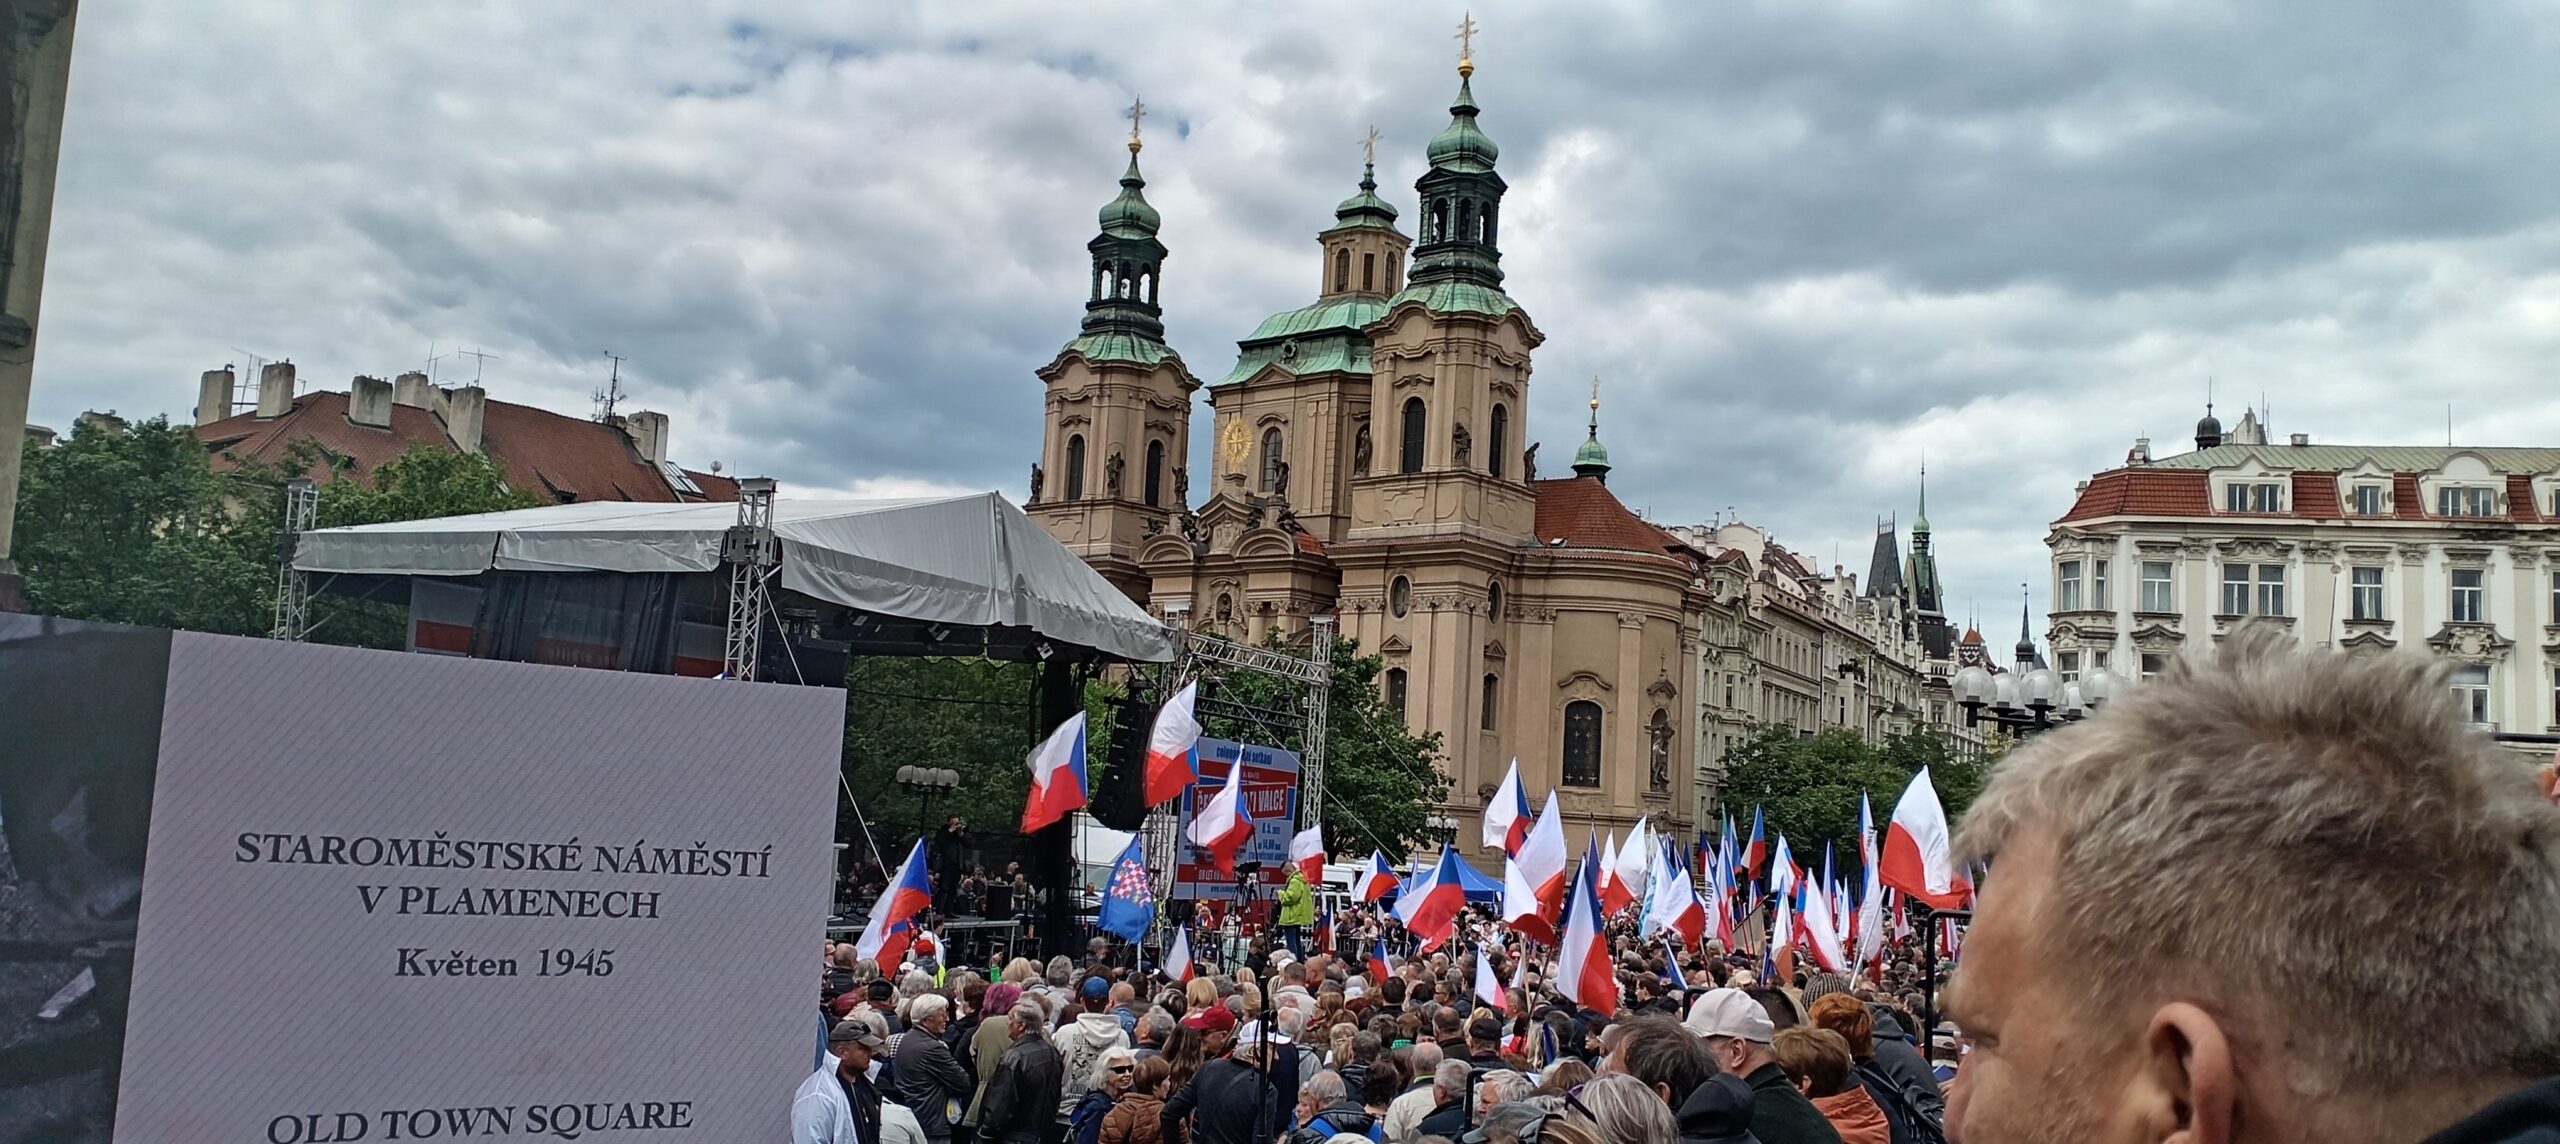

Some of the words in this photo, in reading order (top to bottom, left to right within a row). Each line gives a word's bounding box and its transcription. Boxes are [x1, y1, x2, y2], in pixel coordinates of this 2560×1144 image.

[1258, 786, 1284, 812] VÁLCE
[235, 830, 584, 872] STAROMĚSTSKÉ
[591, 839, 773, 878] NÁMĚSTÍ
[357, 885, 389, 914] V
[396, 886, 662, 919] PLAMENECH
[394, 948, 518, 977] Květen
[537, 948, 615, 977] 1945
[266, 1112, 369, 1144] OLD
[380, 1106, 516, 1140] TOWN
[525, 1101, 694, 1141] SQUARE
